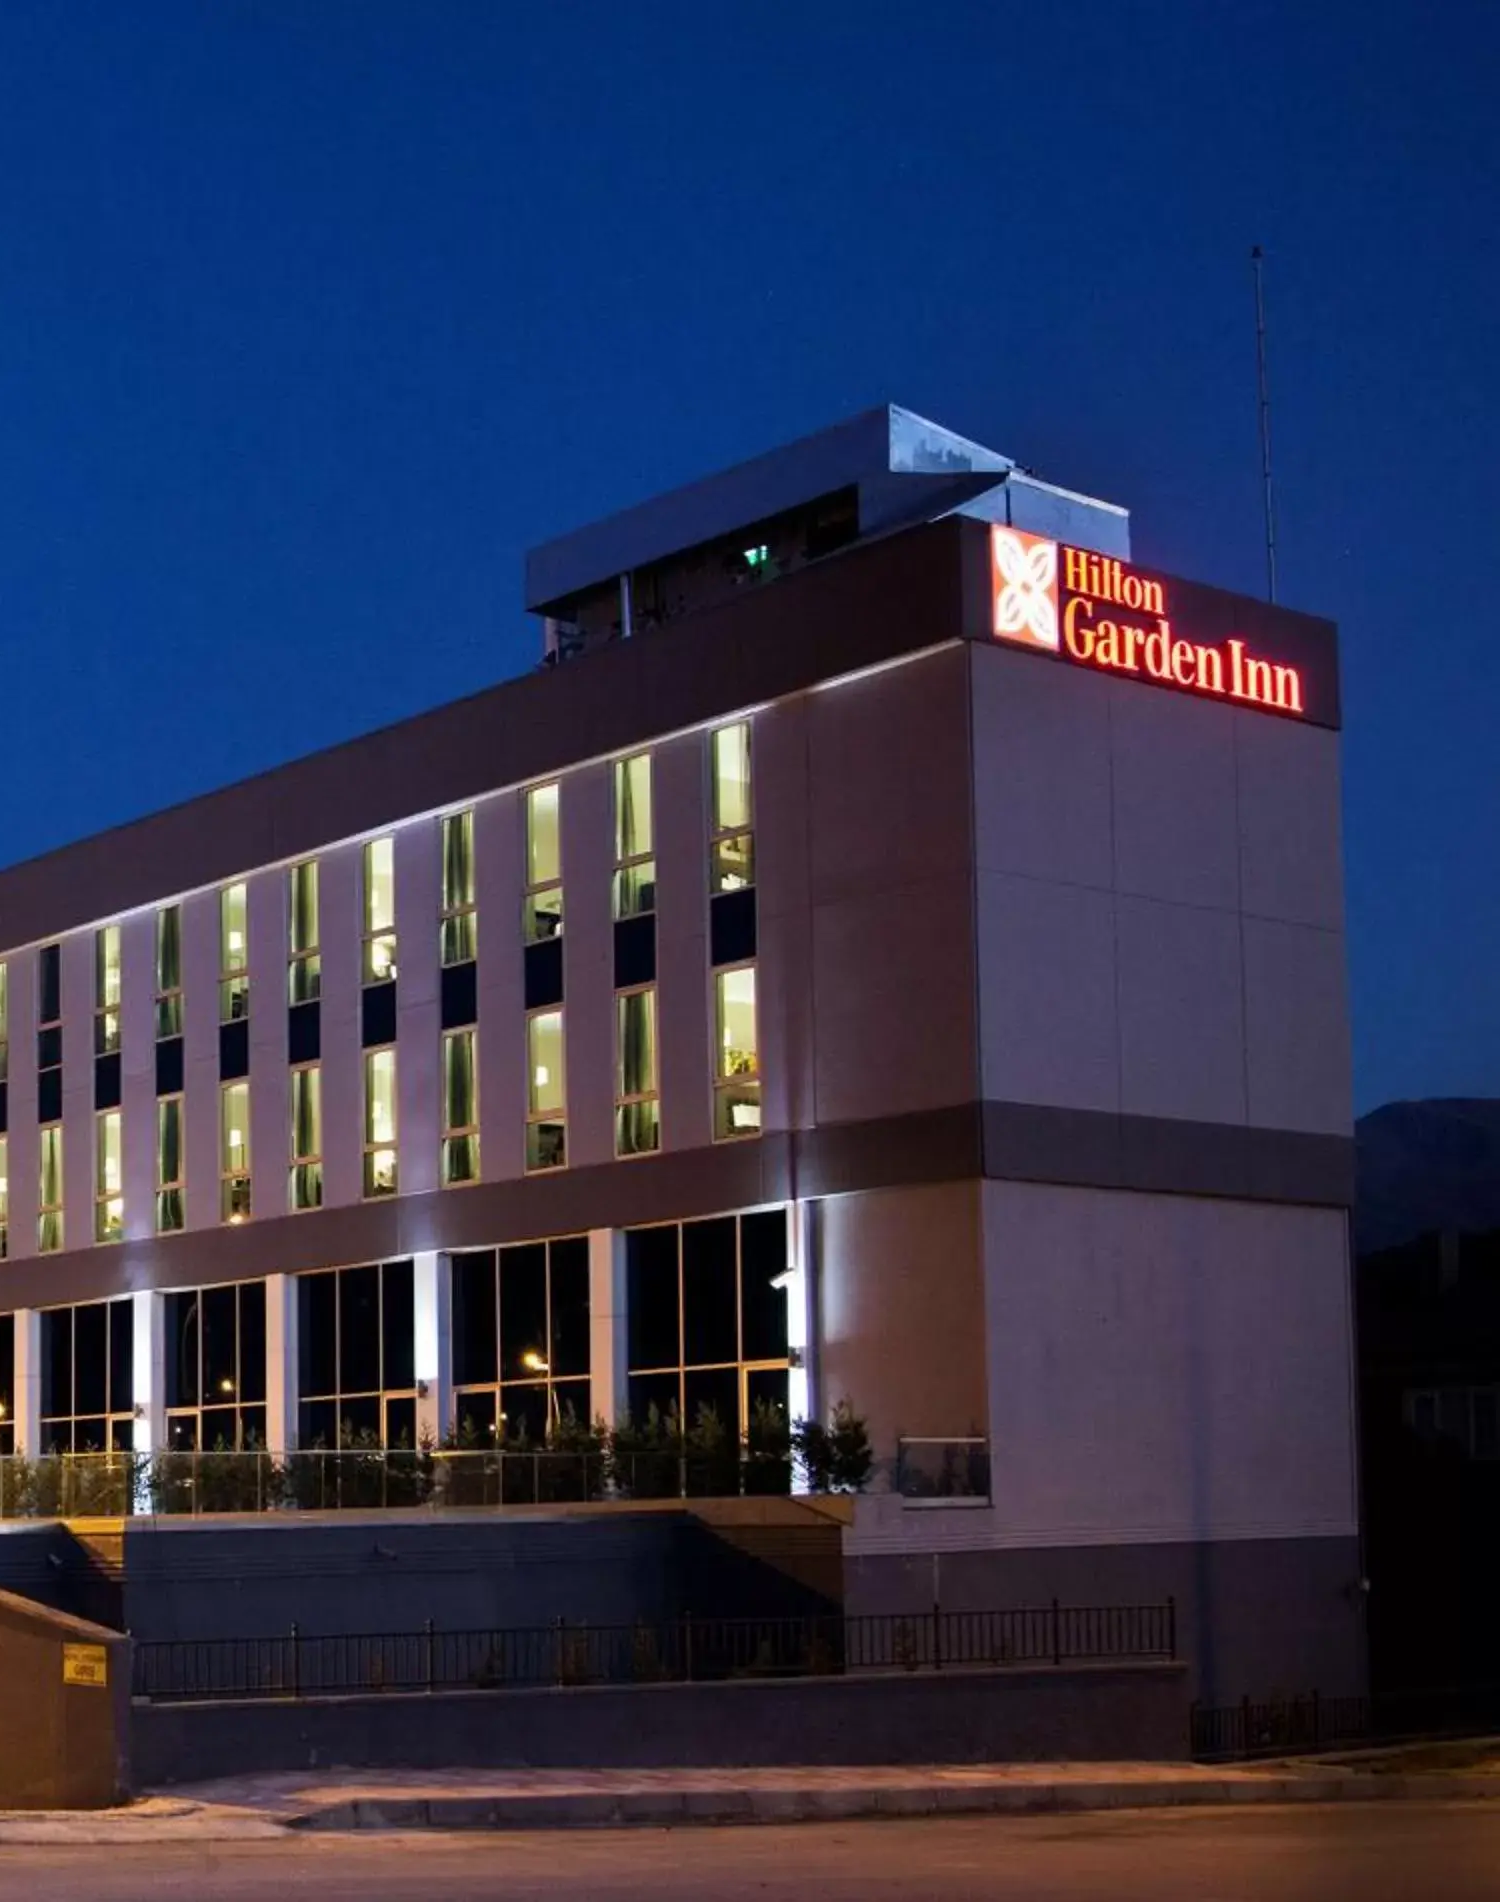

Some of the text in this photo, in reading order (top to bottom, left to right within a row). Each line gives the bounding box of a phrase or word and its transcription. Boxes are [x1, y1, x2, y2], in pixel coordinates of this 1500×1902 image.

[1064, 547, 1164, 615] Hilton
[1063, 597, 1303, 712] Garden Inn
